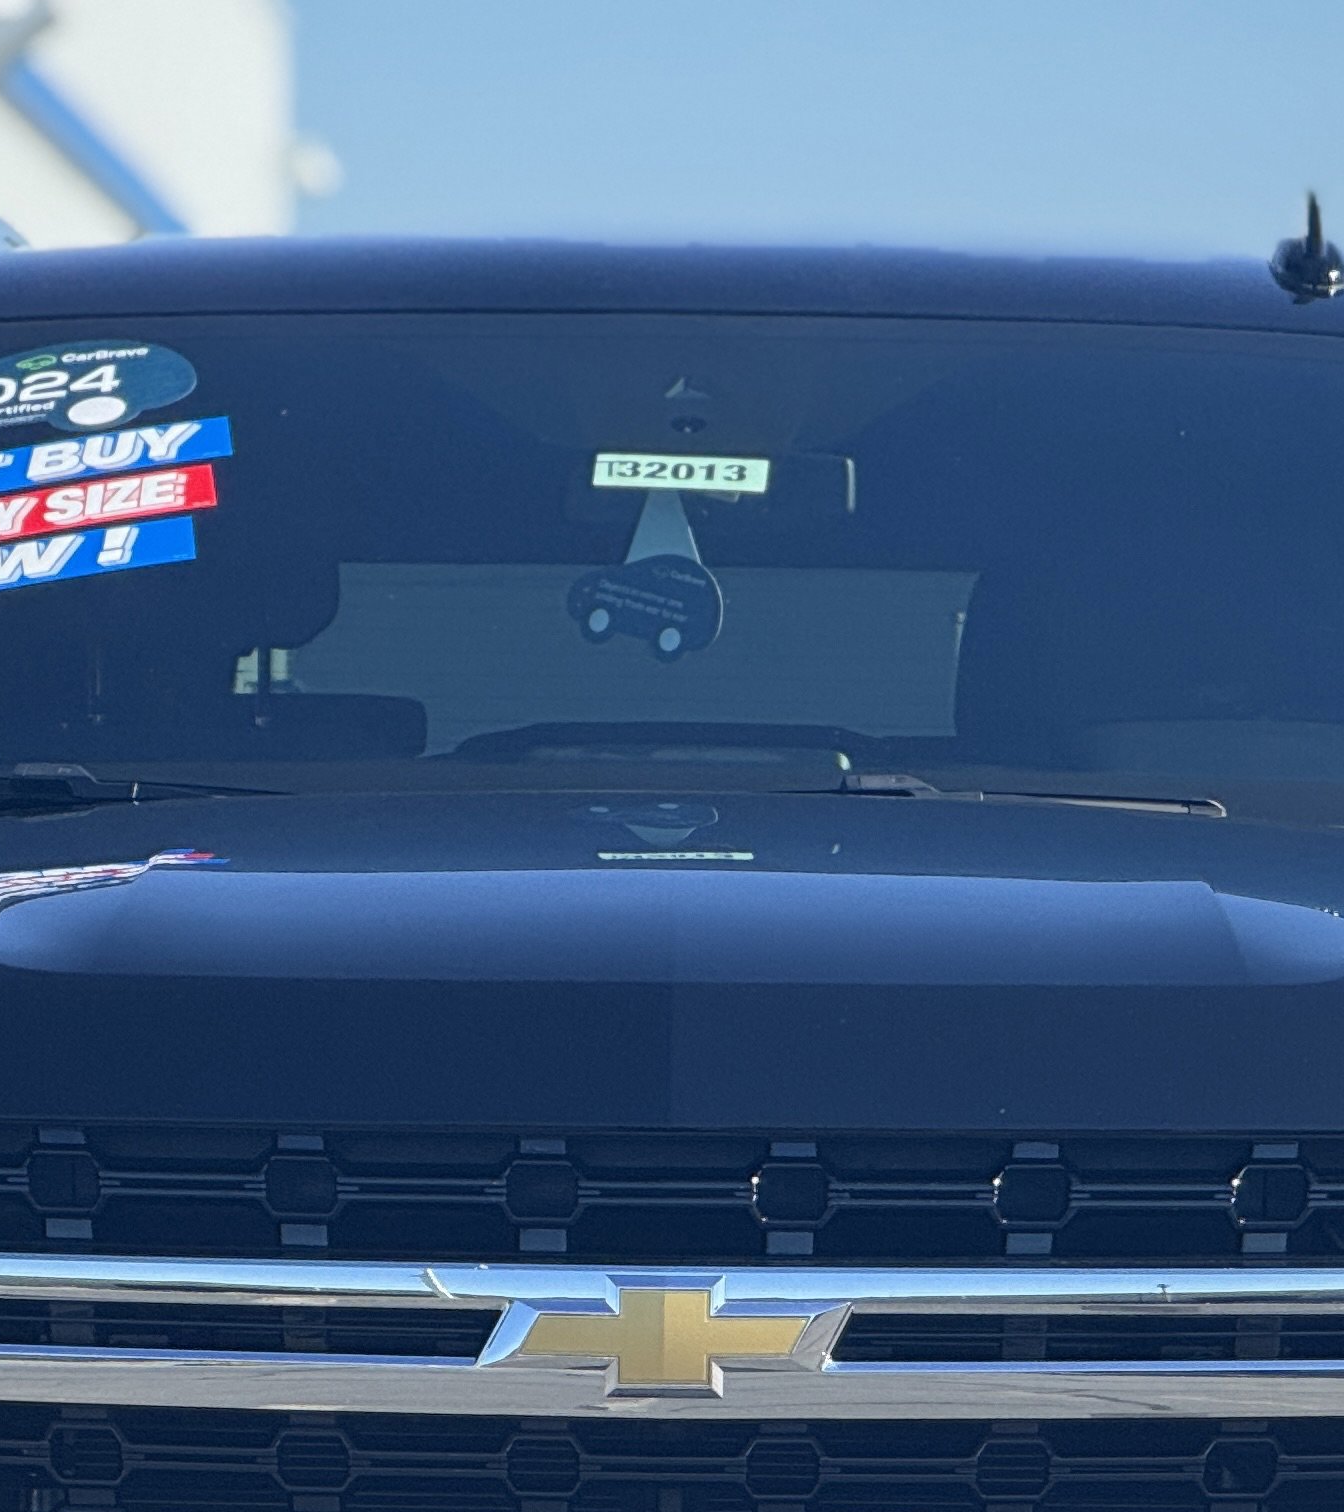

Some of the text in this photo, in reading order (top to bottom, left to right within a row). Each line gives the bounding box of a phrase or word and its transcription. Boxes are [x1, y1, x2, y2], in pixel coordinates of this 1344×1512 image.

[61, 345, 149, 363] CarBravo
[26, 421, 202, 484] BUY
[43, 470, 189, 525] SIZE
